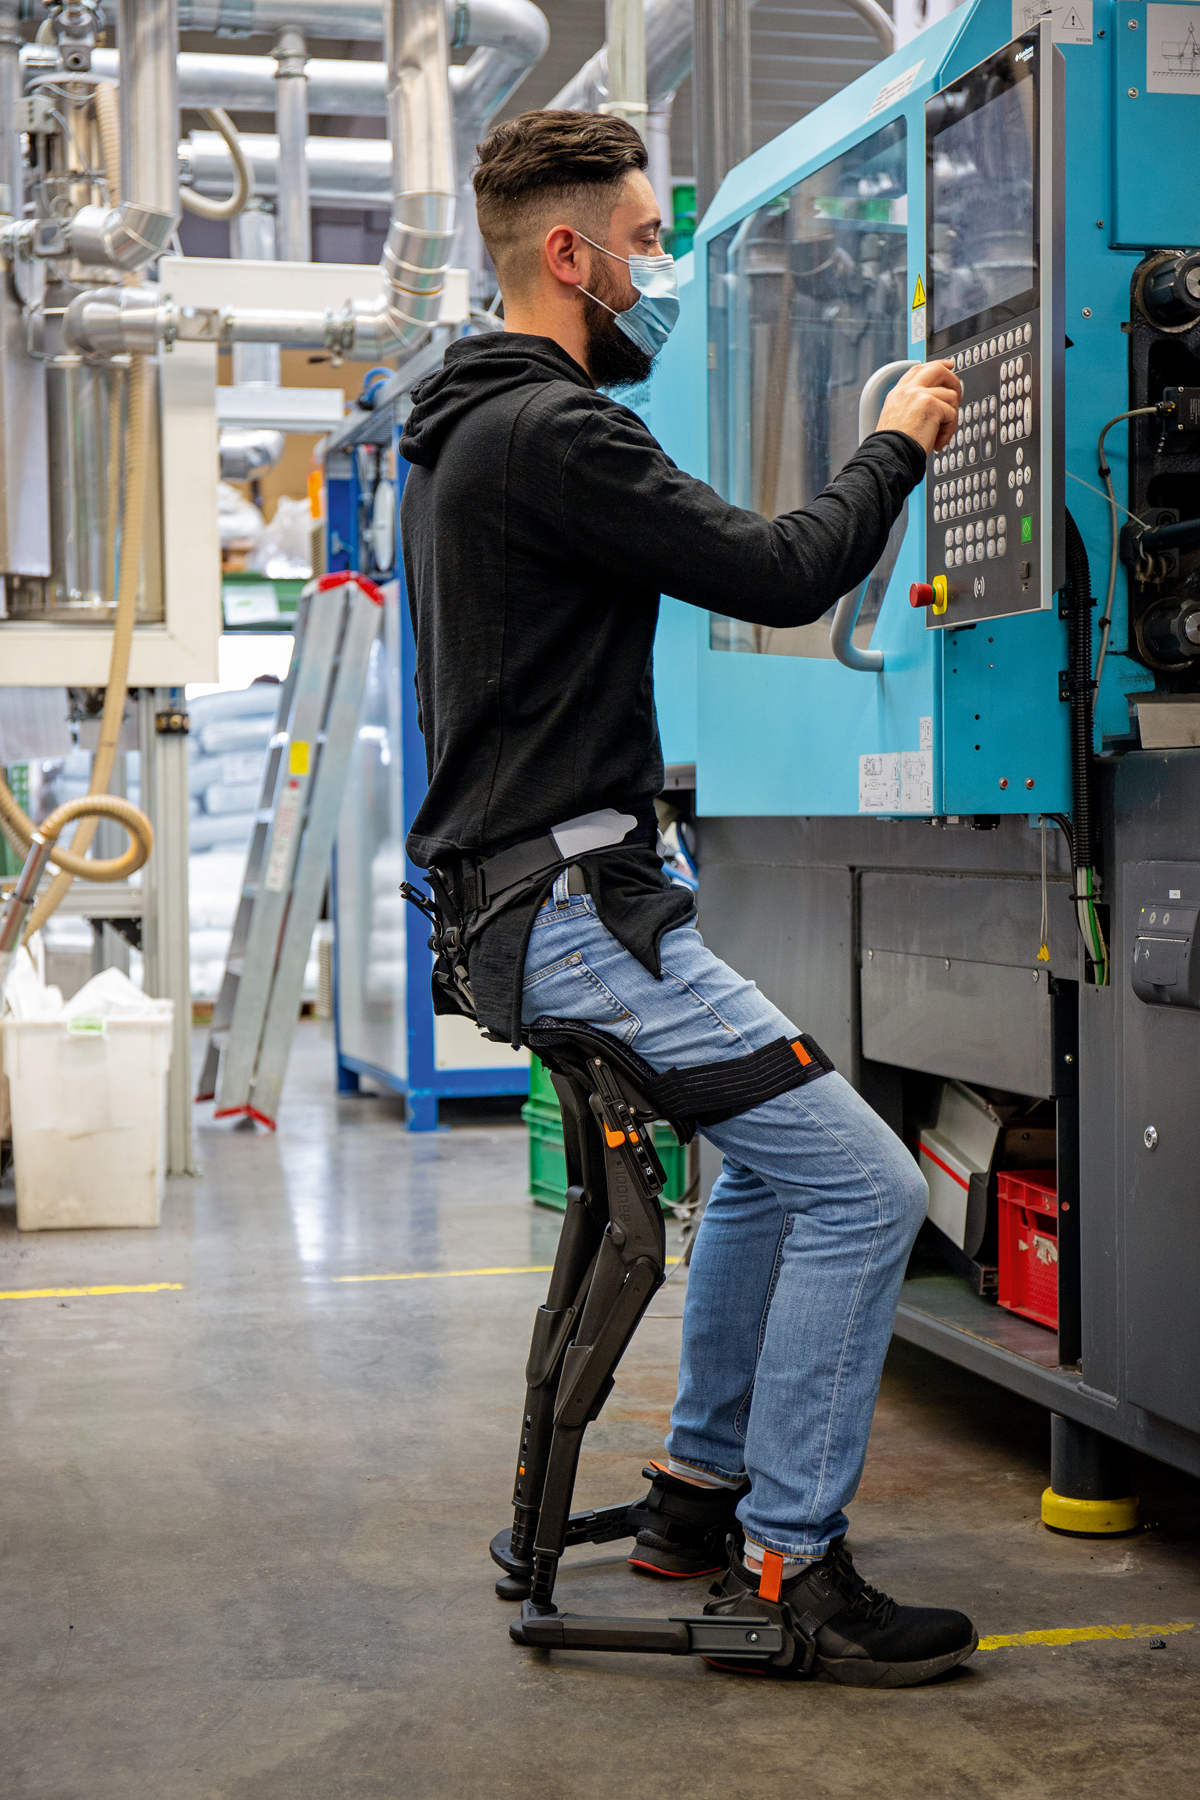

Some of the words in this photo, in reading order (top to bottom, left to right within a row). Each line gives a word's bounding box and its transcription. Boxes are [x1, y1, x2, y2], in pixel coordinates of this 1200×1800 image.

[626, 1124, 635, 1132] M
[645, 1166, 654, 1176] XS
[615, 1166, 630, 1221] noonee
